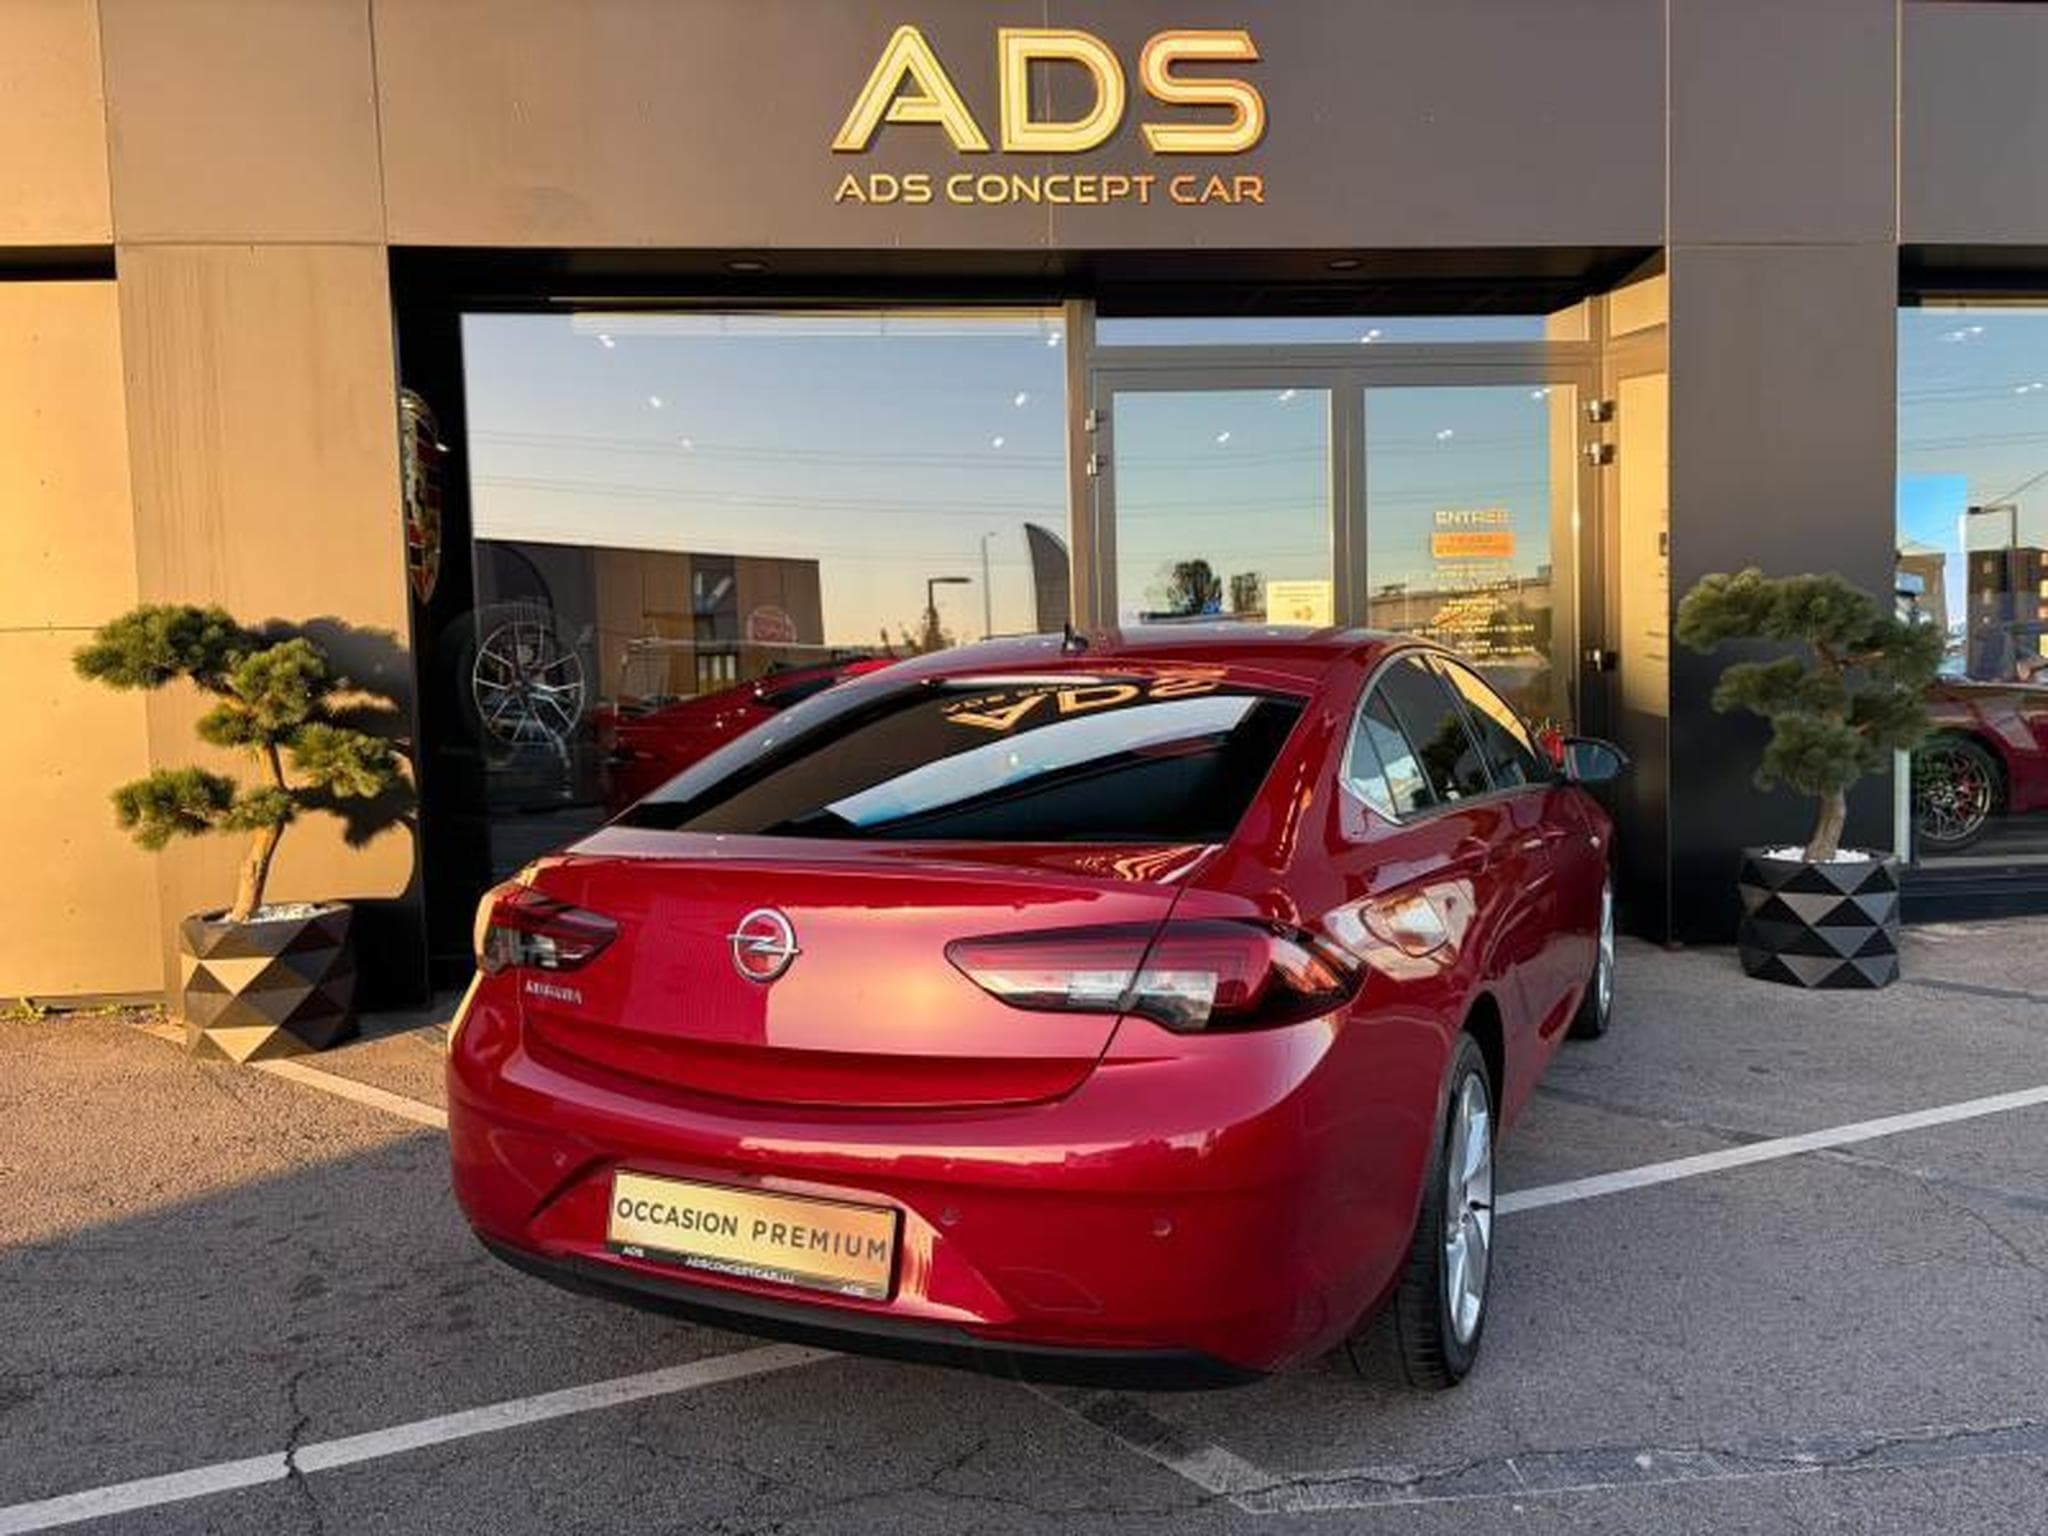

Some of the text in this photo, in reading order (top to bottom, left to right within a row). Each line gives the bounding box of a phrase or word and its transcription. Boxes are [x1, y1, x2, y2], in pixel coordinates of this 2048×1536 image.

[832, 25, 1266, 153] ADS
[835, 174, 1265, 203] ADS CONCEPT CAR
[616, 1197, 886, 1263] OCCASION PREMIUM
